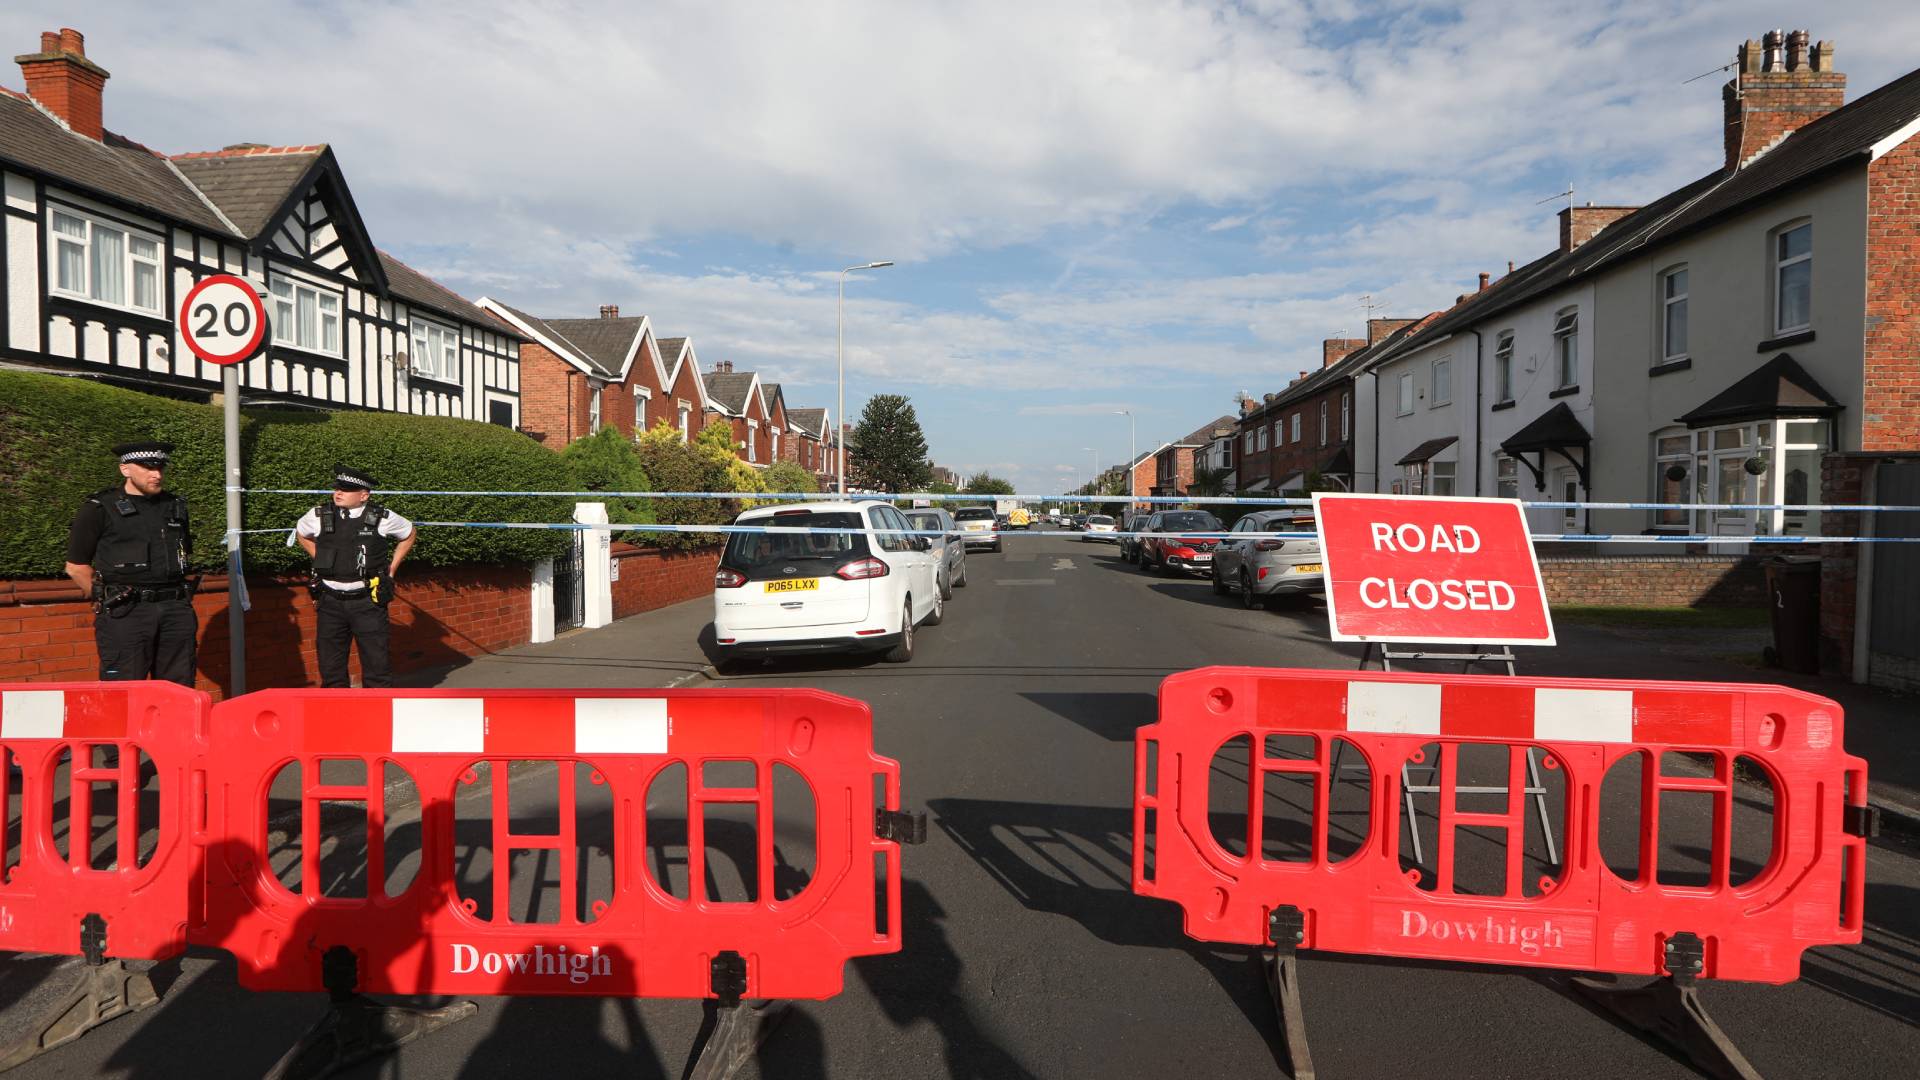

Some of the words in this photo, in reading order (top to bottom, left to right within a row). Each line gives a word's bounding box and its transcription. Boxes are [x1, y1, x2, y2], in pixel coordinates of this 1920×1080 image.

[194, 302, 250, 338] 20
[1371, 522, 1481, 554] ROAD
[767, 581, 793, 592] PO65
[795, 579, 815, 590] LXX
[1359, 577, 1516, 611] CLOSED
[1400, 909, 1564, 957] Dowhigh
[450, 943, 613, 984] Dowhigh
